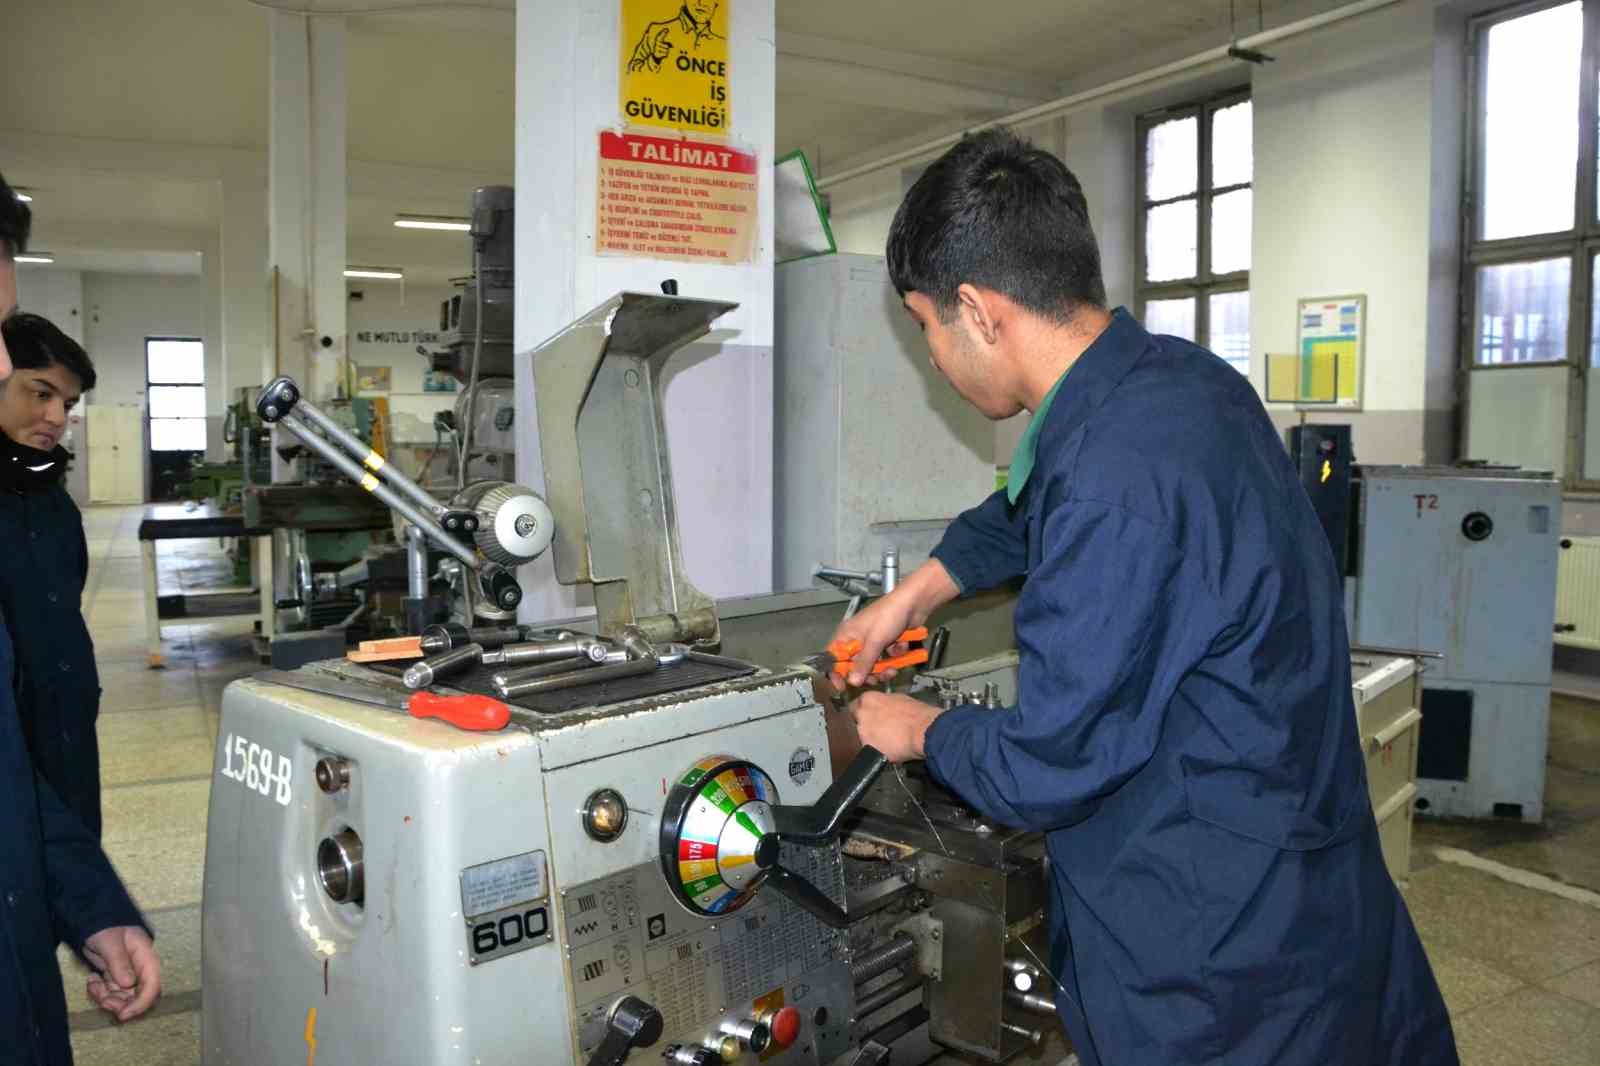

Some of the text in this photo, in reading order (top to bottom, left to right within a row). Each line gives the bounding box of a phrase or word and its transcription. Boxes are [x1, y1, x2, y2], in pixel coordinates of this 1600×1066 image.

[676, 50, 726, 77] ÖNCE
[711, 81, 726, 105] İŞ
[625, 97, 726, 128] GÜVENLİĞİ
[628, 142, 732, 168] TALİMAT
[357, 331, 371, 343] NE
[374, 331, 409, 343] MUTLU
[221, 732, 292, 806] 1569-B
[689, 843, 703, 859] 175
[472, 907, 548, 955] 600
